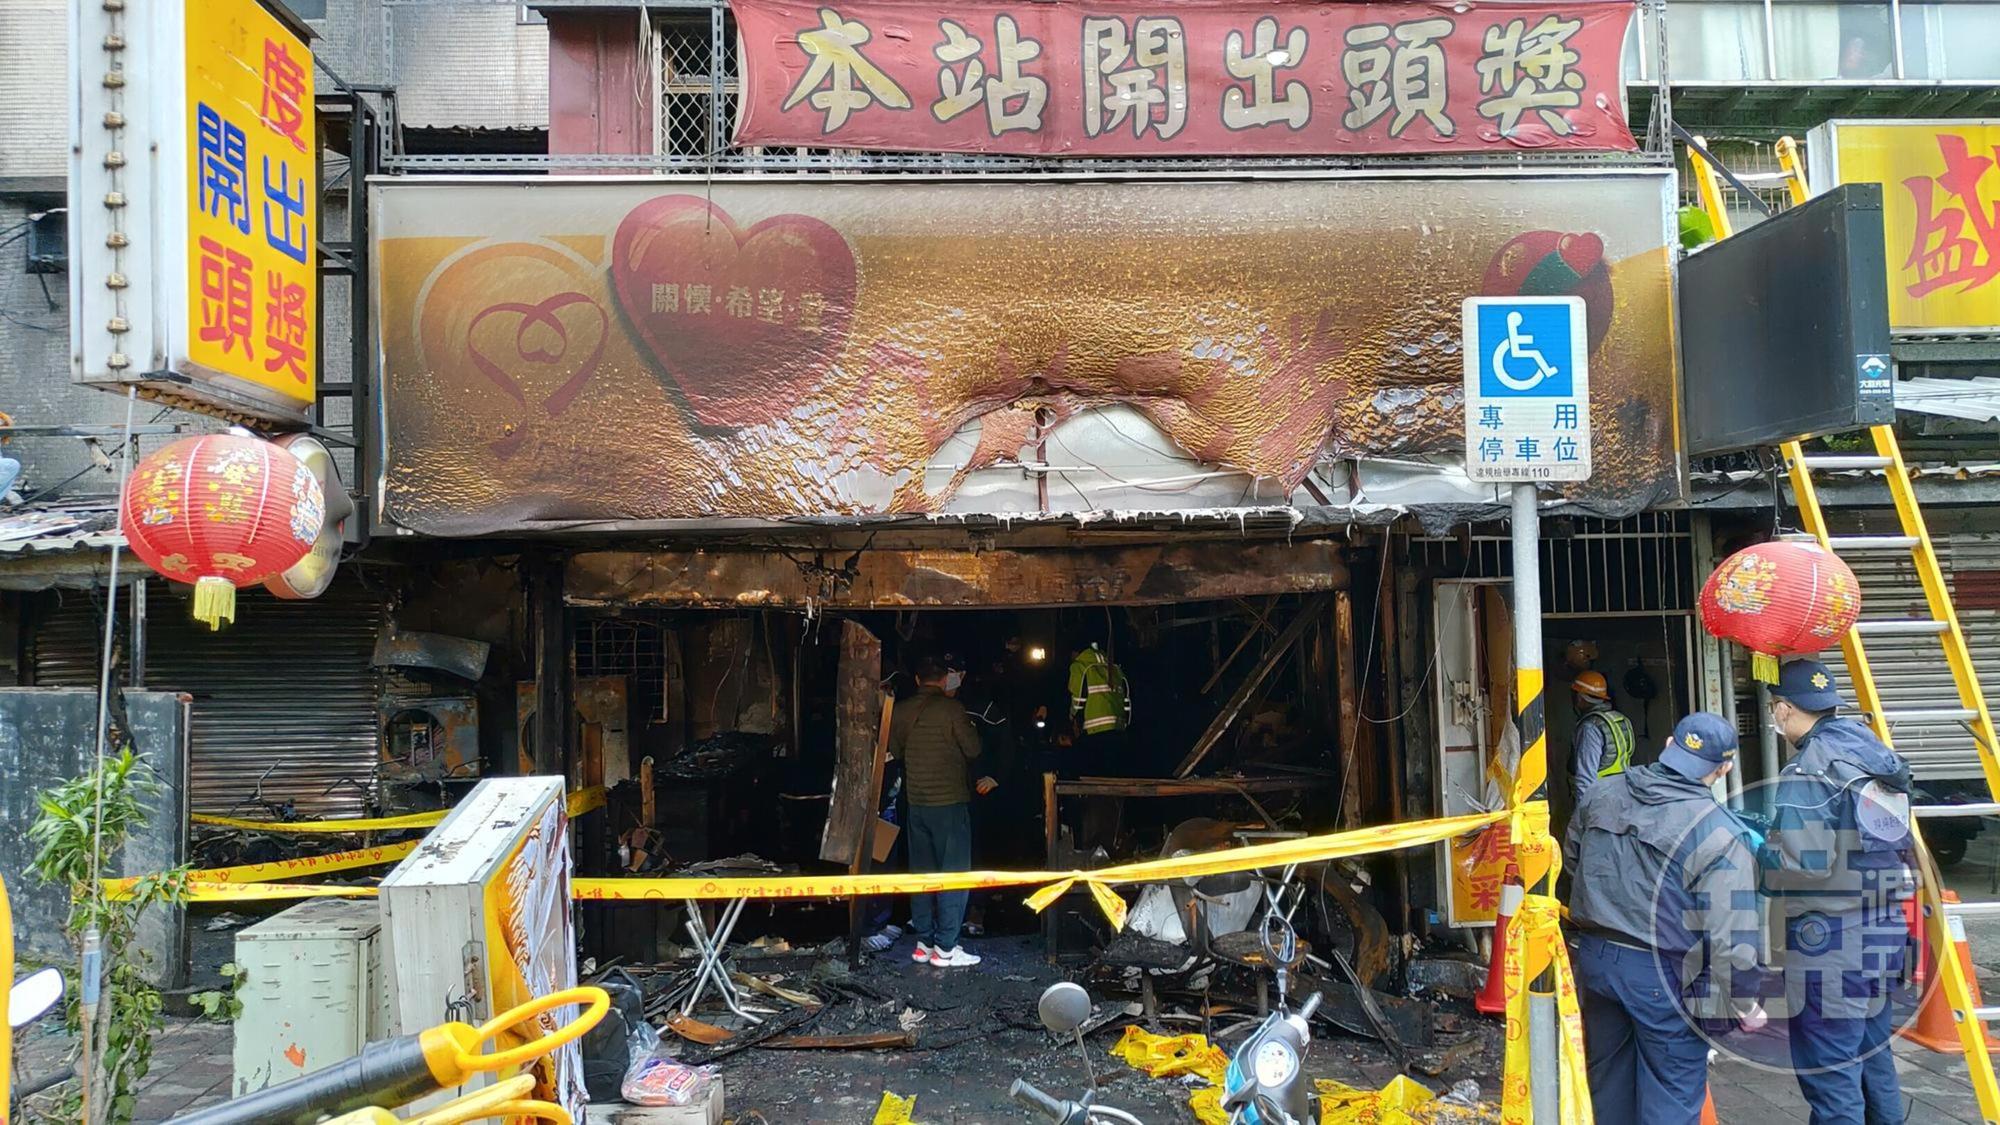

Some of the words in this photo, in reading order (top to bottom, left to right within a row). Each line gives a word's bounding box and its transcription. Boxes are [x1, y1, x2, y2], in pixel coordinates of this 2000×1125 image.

[783, 8, 1586, 140] 本站開出頭獎
[1479, 404, 1578, 430] 專用
[1478, 436, 1579, 462] 停車位
